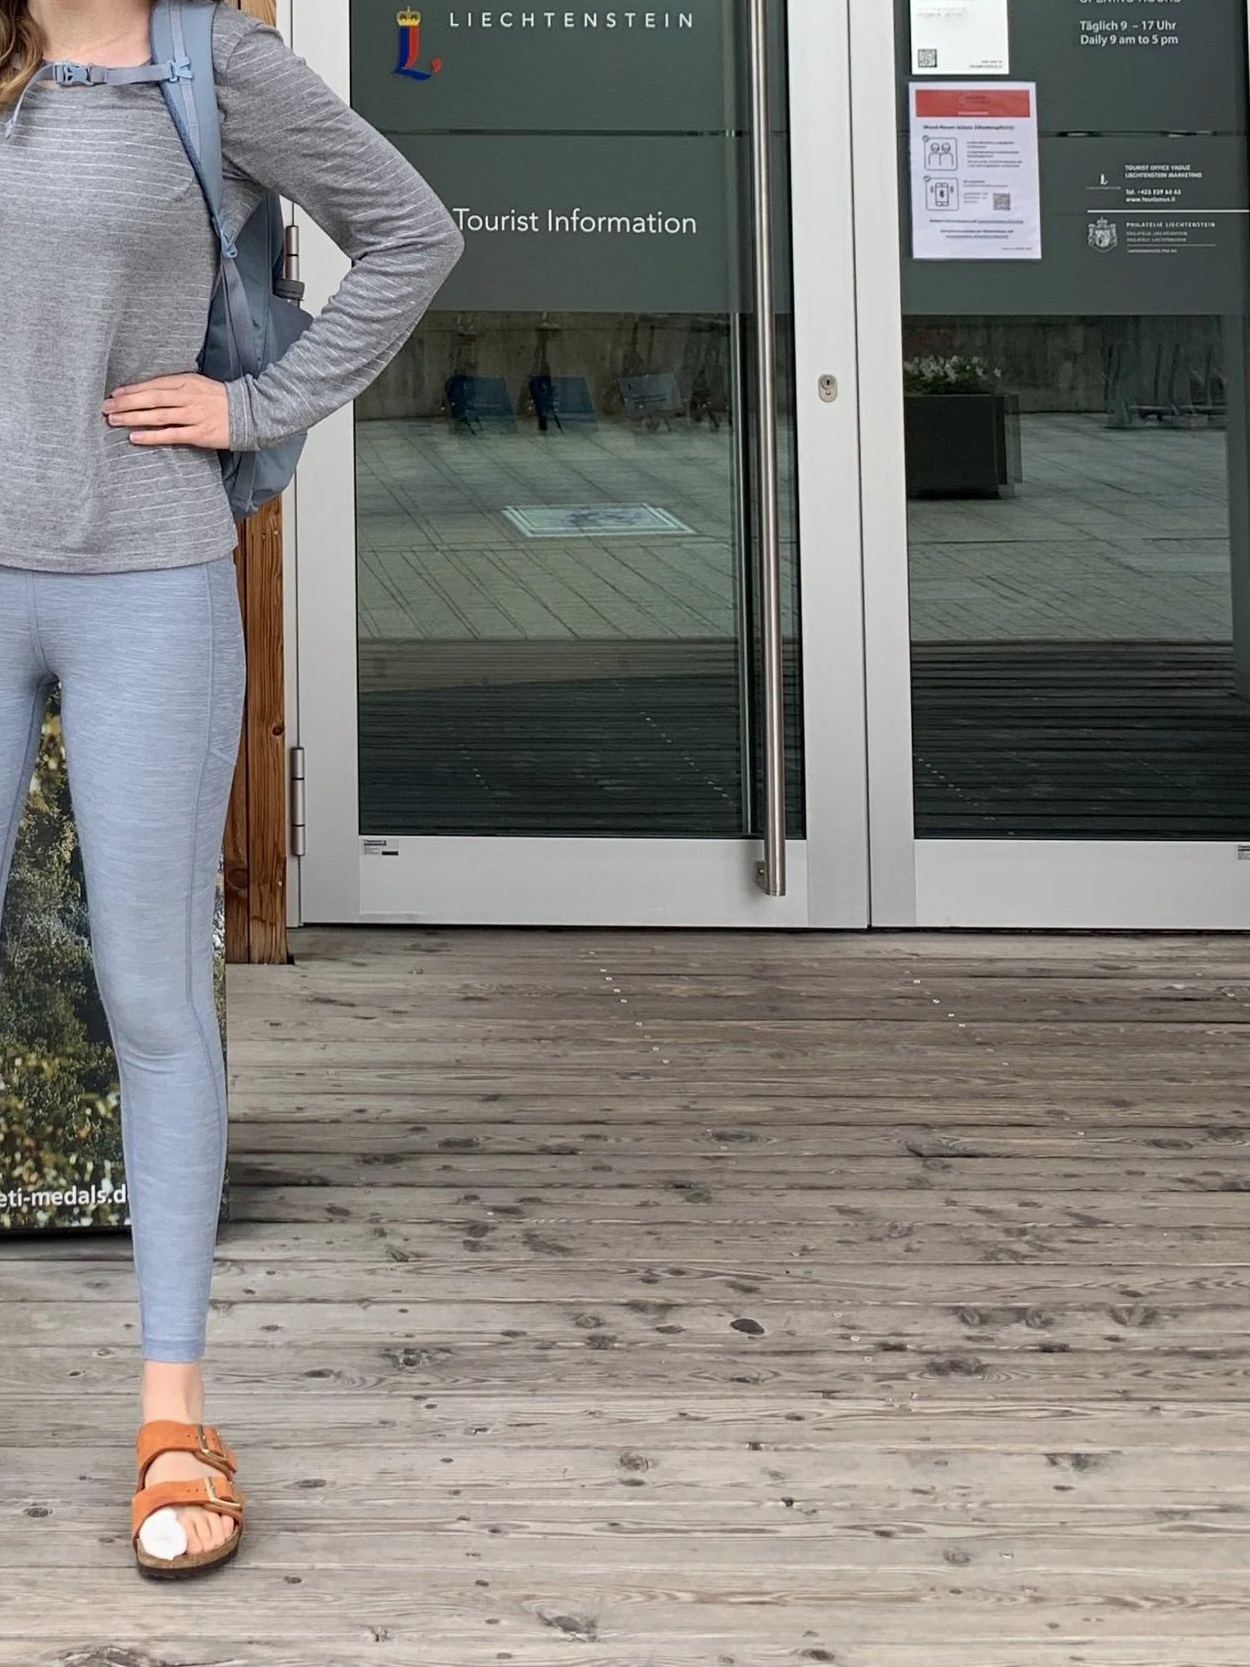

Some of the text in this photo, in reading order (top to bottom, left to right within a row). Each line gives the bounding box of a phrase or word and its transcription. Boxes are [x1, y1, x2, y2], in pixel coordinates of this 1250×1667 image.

[449, 12, 693, 28] LIECHTENSTEIN
[1079, 20, 1118, 33] Täglich
[1120, 21, 1127, 30] 9
[1141, 21, 1154, 31] 17
[1156, 20, 1177, 31] Uhr
[1080, 34, 1179, 47] Daily 9 am to 5 pm
[453, 208, 696, 234] Tourist Information
